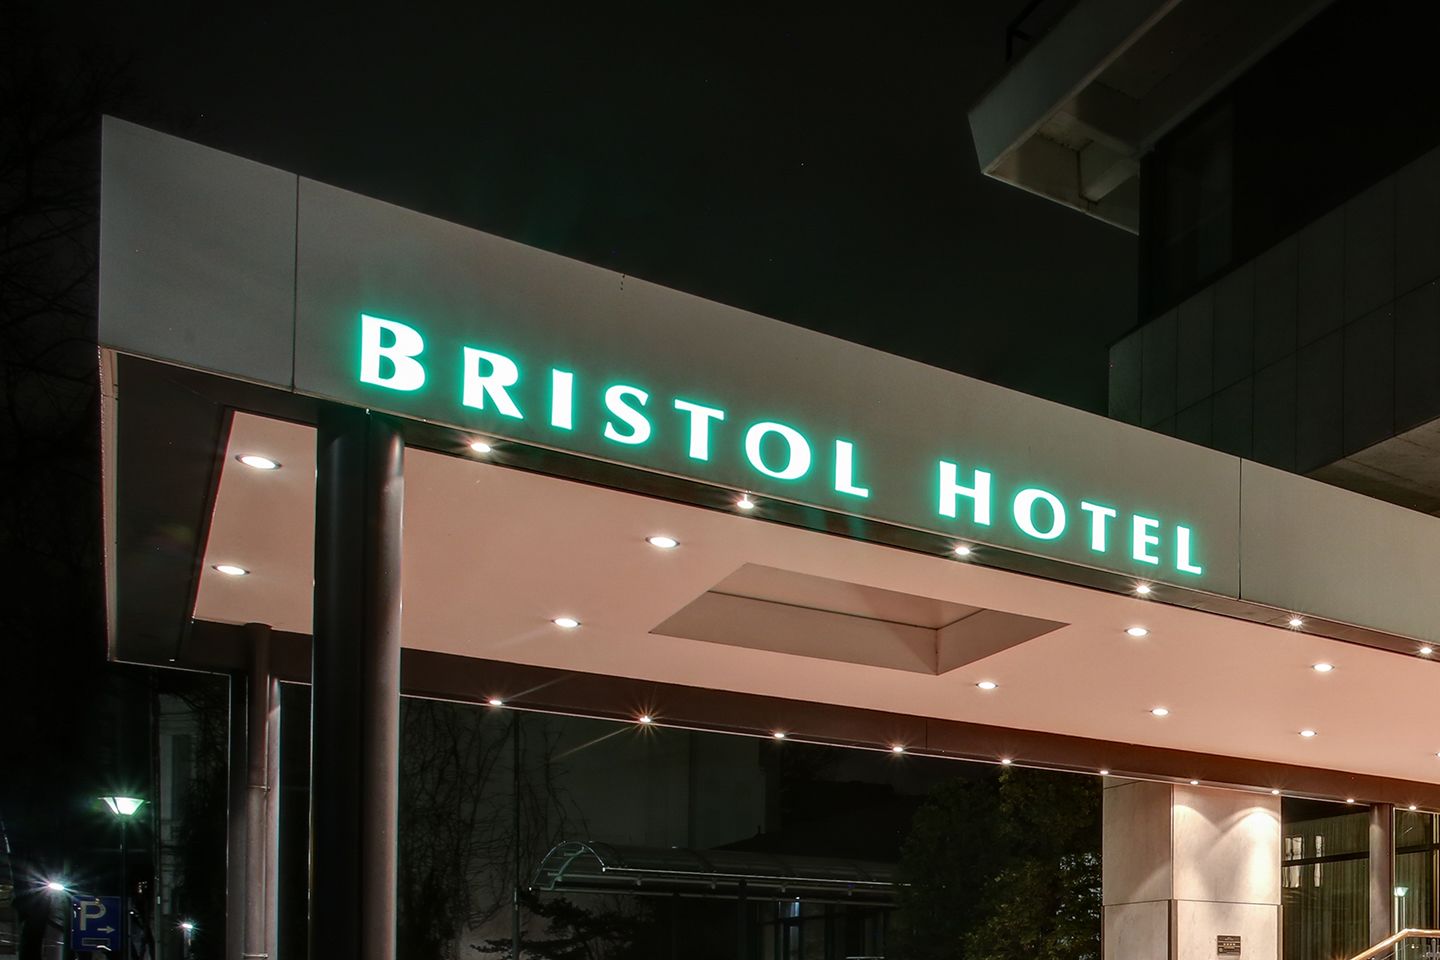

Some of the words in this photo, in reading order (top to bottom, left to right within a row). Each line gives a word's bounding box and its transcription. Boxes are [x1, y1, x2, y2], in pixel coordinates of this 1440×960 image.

[358, 313, 870, 499] BRISTOL
[937, 459, 1204, 576] HOTEL
[80, 900, 107, 931] P
